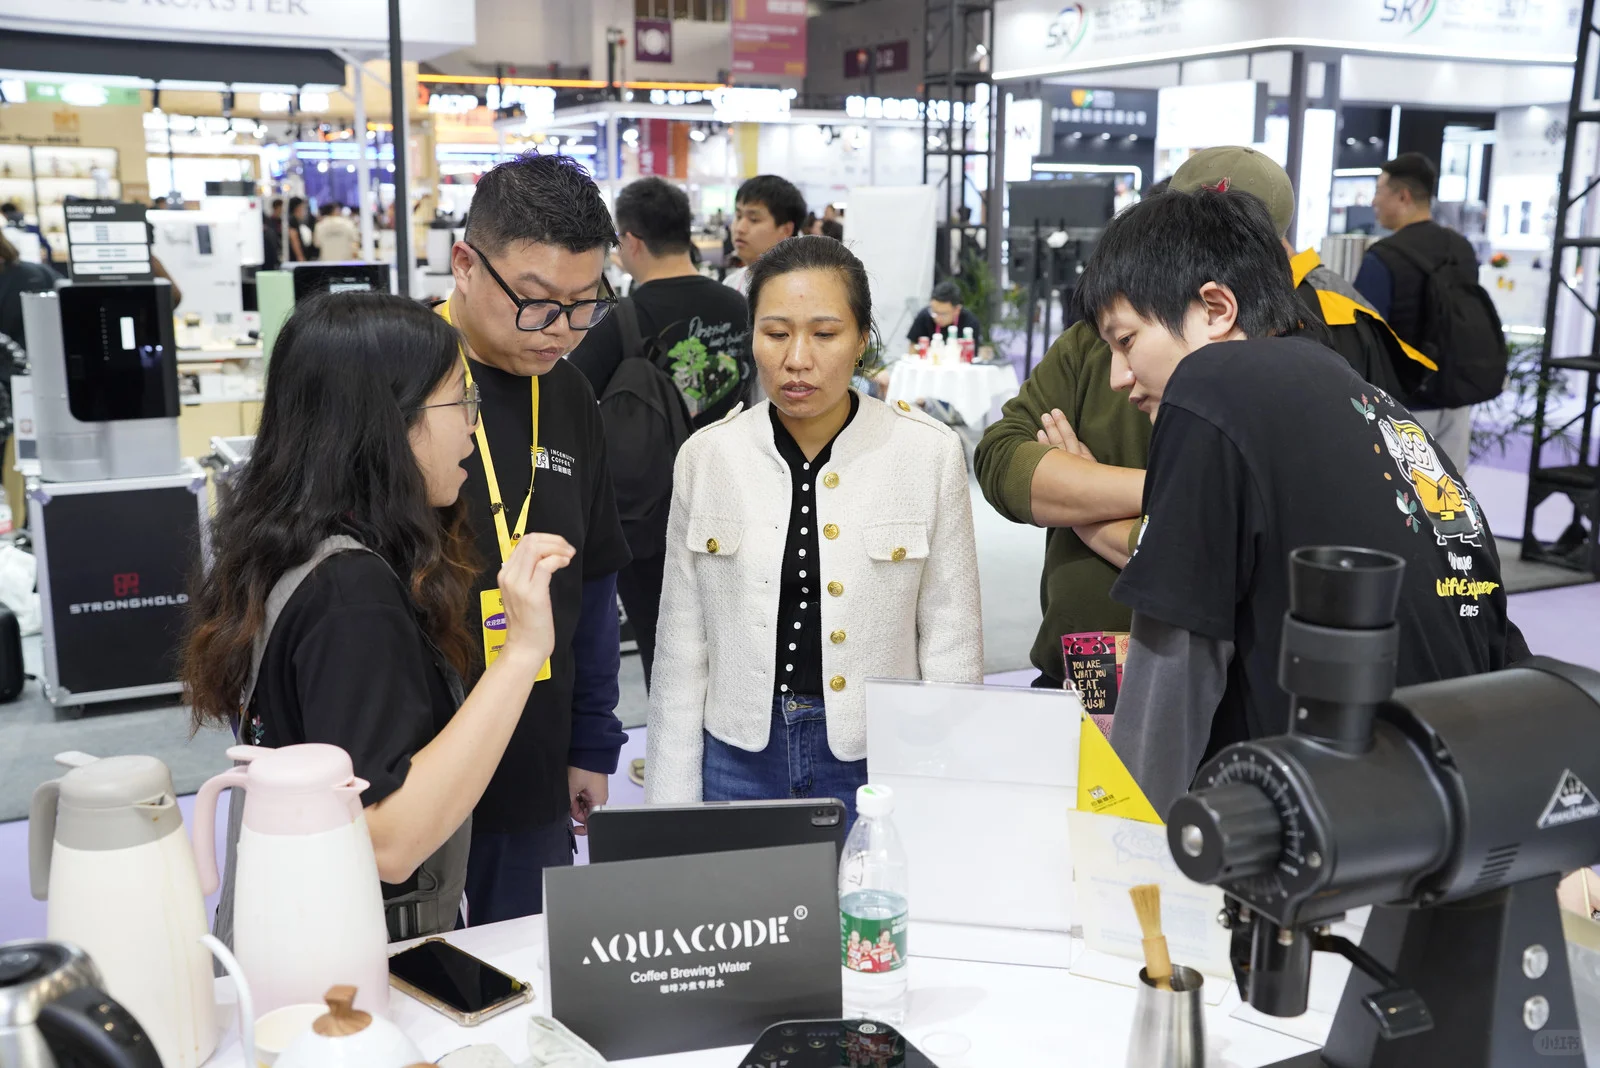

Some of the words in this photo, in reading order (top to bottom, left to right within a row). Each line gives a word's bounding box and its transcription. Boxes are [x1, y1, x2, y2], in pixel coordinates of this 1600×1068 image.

[551, 456, 571, 467] COFFEE
[69, 593, 189, 614] STRONGHOLD
[1072, 661, 1084, 669] YOU
[1086, 659, 1101, 669] ARE
[1074, 669, 1092, 678] WHAT
[1095, 669, 1106, 677] YOU
[1094, 689, 1106, 698] AM
[582, 916, 790, 965] AQUACODE
[630, 967, 668, 984] Coffee
[670, 965, 716, 980] Brewing
[718, 961, 751, 974] Water
